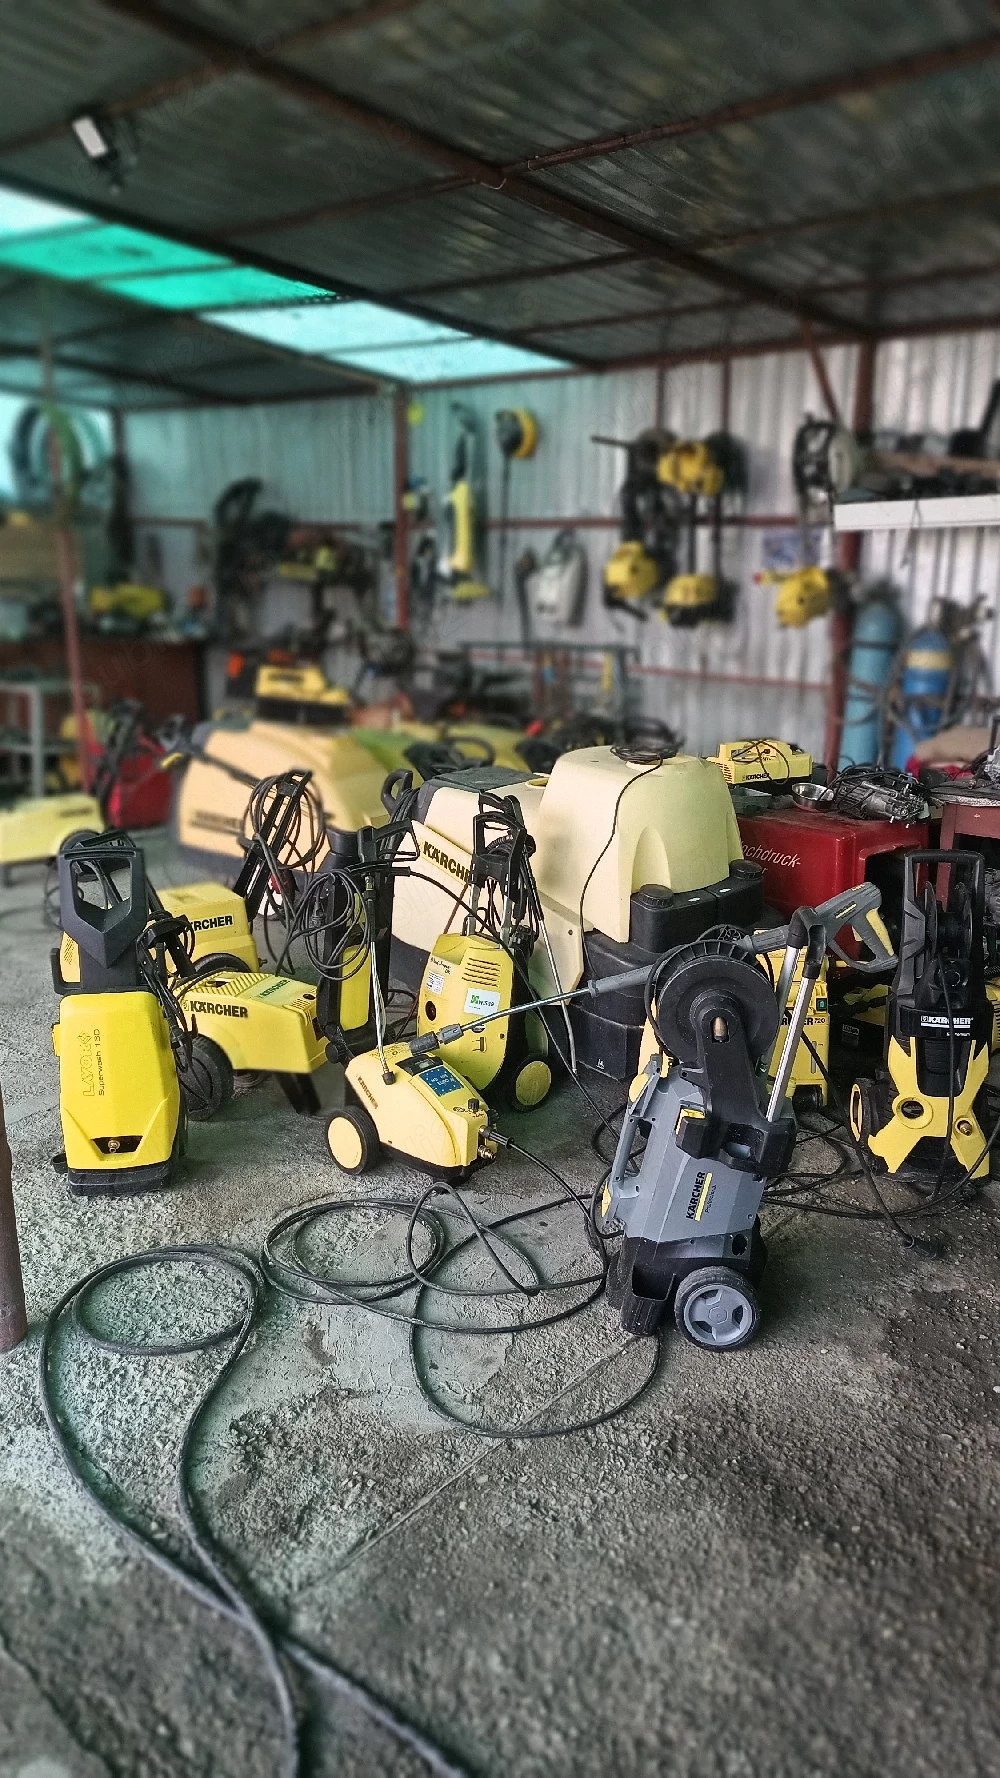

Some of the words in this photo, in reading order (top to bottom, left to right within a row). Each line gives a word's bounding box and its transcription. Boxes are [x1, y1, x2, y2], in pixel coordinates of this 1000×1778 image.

[190, 915, 233, 931] RCHER
[190, 1001, 248, 1018] KÄRCHER
[686, 1171, 706, 1220] KÄRCHER
